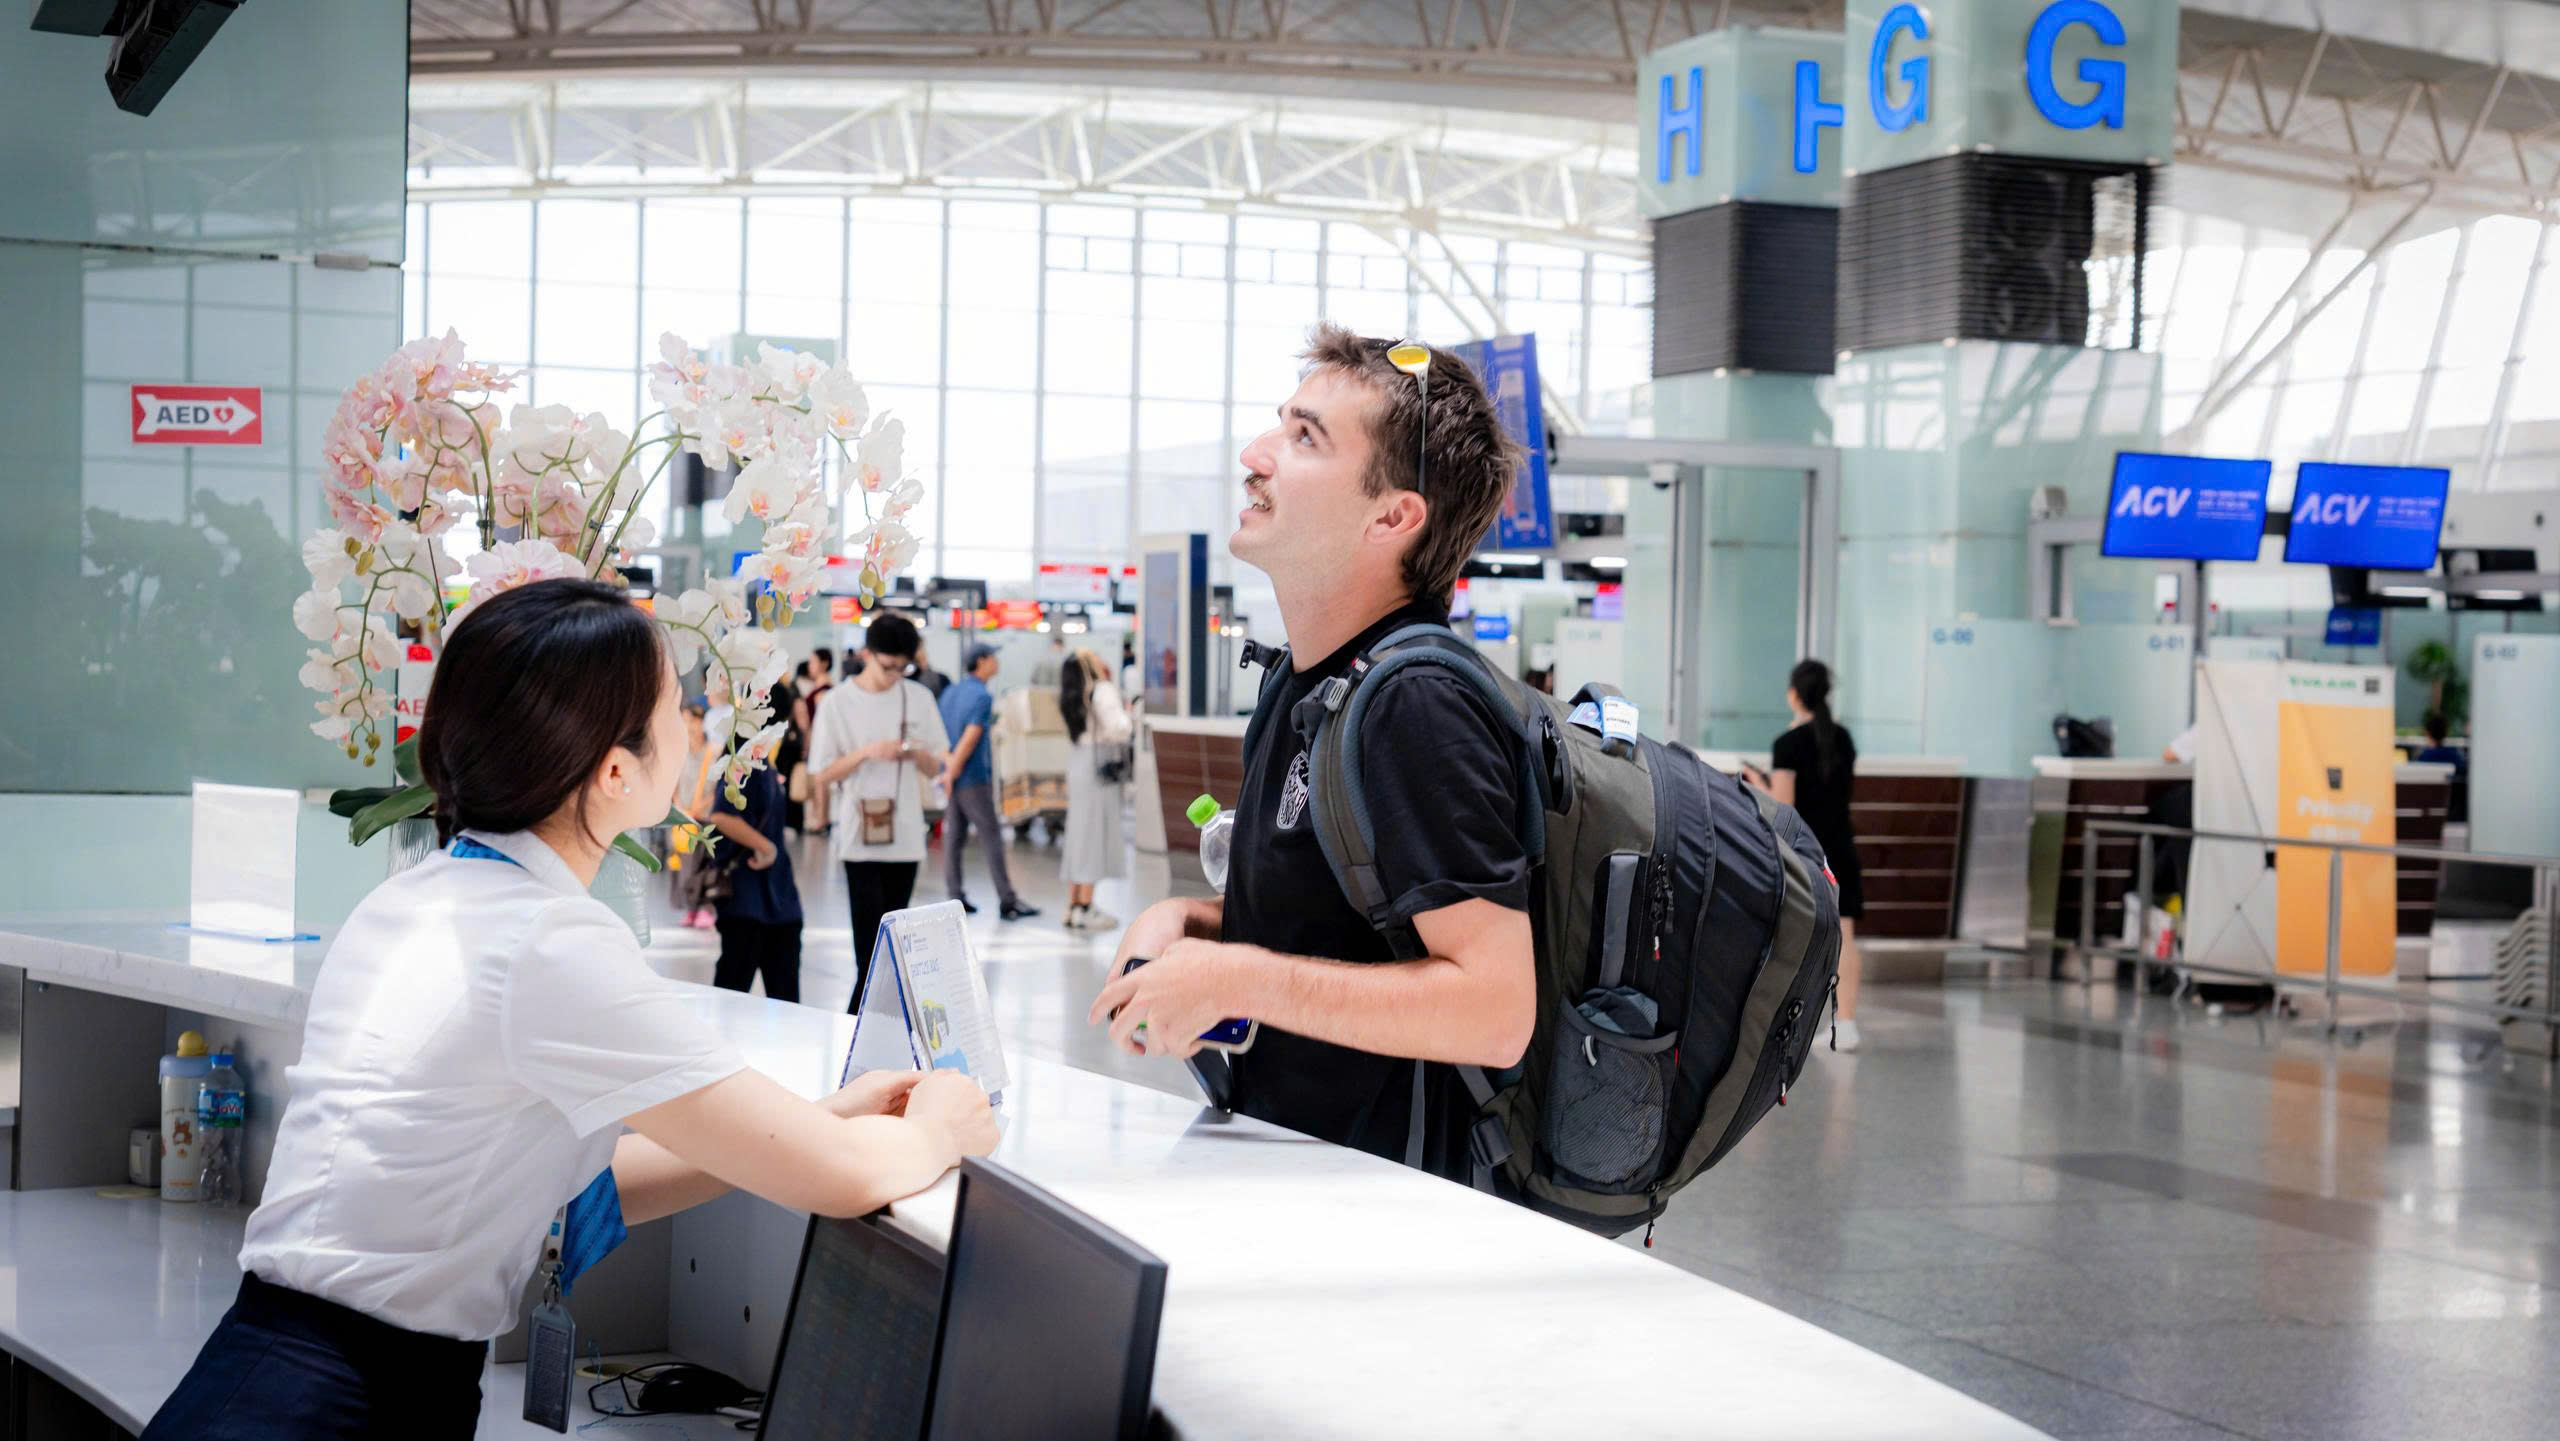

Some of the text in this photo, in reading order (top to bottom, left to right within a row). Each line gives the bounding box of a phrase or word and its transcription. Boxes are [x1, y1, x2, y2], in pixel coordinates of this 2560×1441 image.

[1870, 3, 1930, 132] G
[2026, 0, 2128, 129] G
[1657, 66, 1704, 183] H
[156, 405, 210, 424] AED
[2114, 484, 2192, 518] ACV
[2292, 491, 2371, 526] ACV
[397, 698, 426, 715] AE
